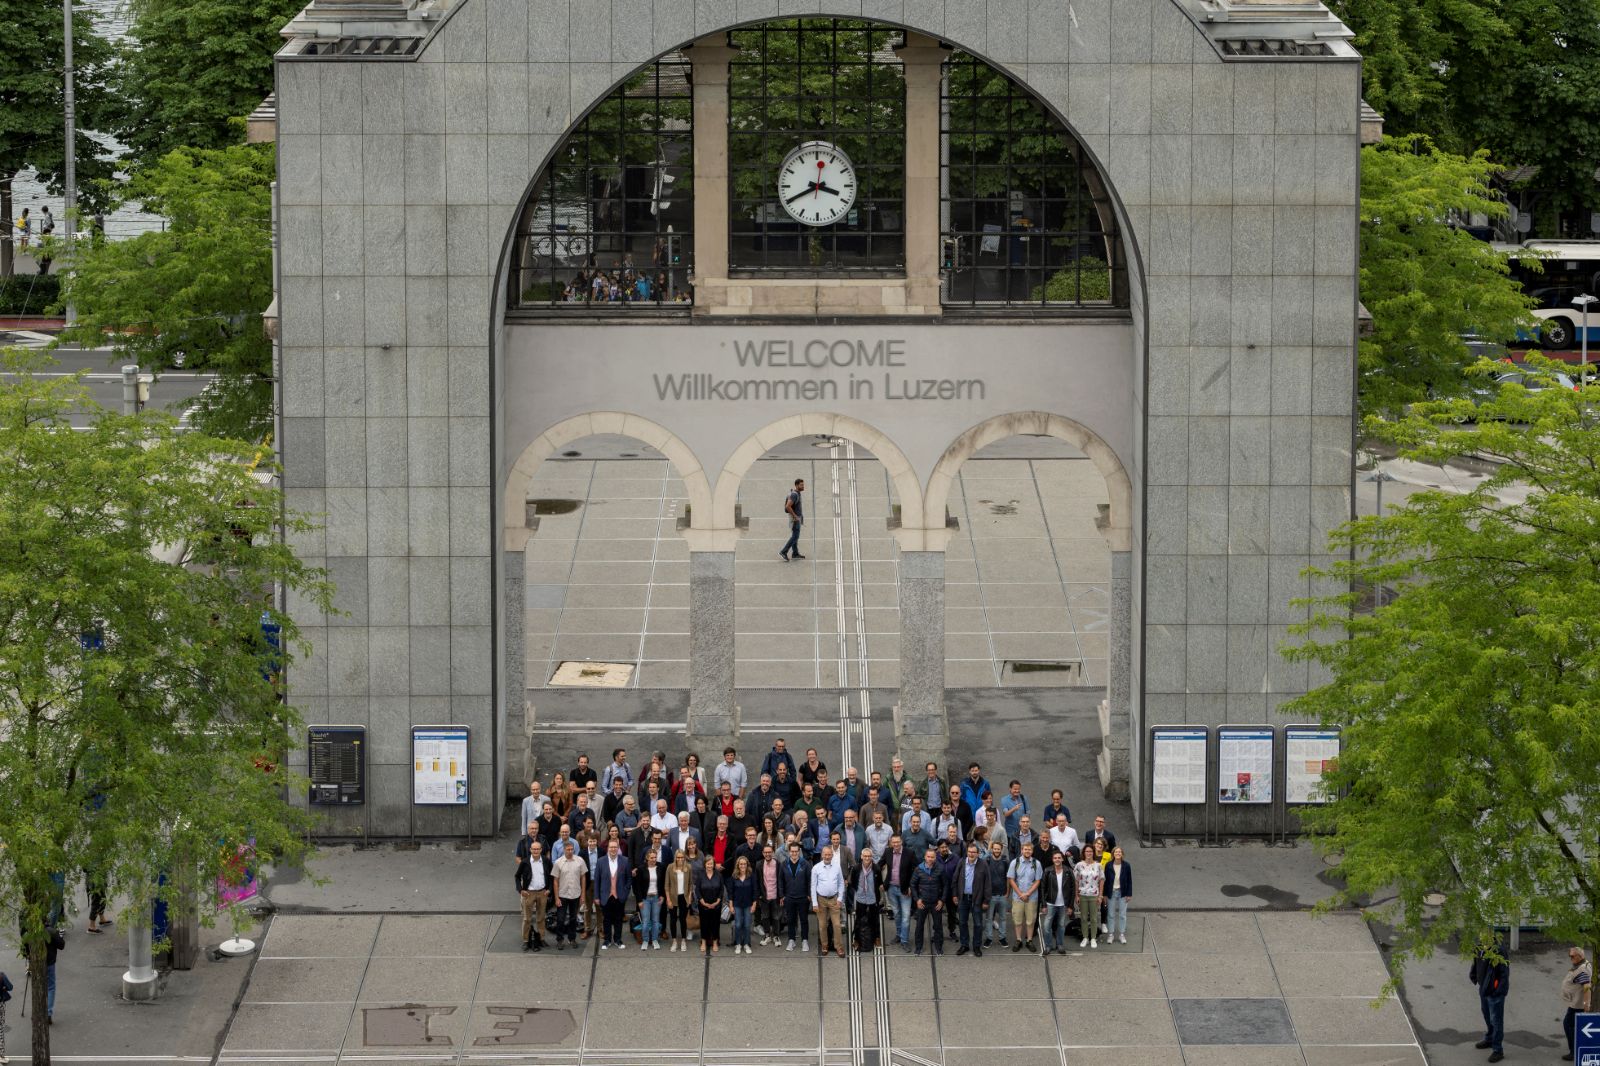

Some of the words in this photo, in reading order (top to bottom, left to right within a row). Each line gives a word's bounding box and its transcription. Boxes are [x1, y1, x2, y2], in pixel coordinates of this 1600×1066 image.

[734, 340, 906, 368] WELCOME
[653, 373, 838, 401] Willkommen
[849, 373, 874, 400] in
[885, 373, 986, 401] Luzern
